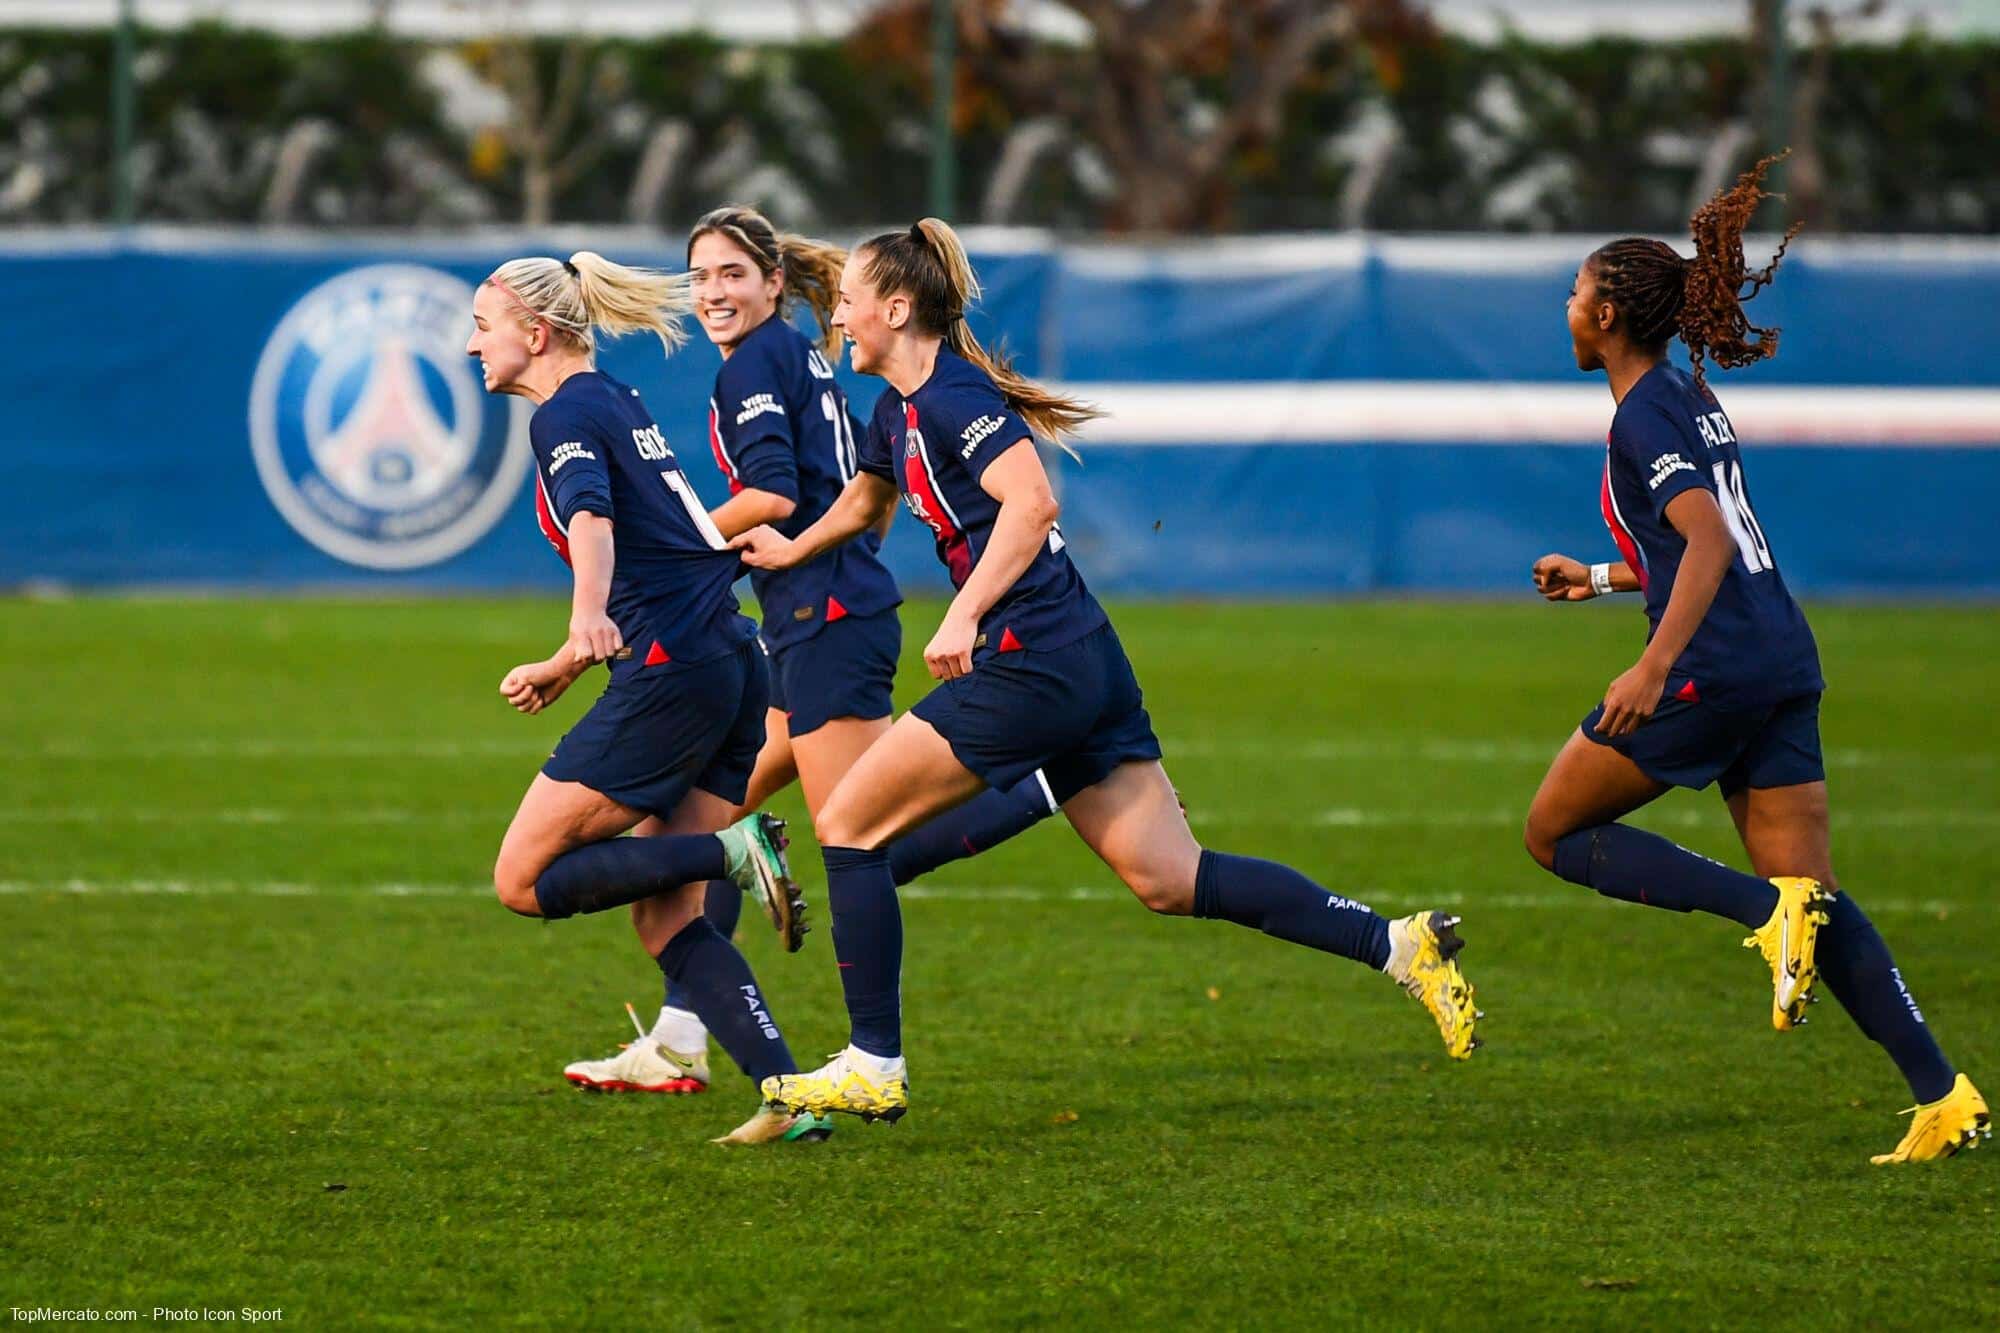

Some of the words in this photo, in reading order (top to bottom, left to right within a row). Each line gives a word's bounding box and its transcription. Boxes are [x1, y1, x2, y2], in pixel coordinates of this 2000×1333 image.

[960, 414, 991, 441] VISIT
[961, 415, 1007, 460] RWANDA
[550, 441, 582, 459] VISIT
[1650, 453, 1681, 471] VISIT
[1327, 895, 1371, 913] PARIS
[739, 984, 780, 1040] PARIS
